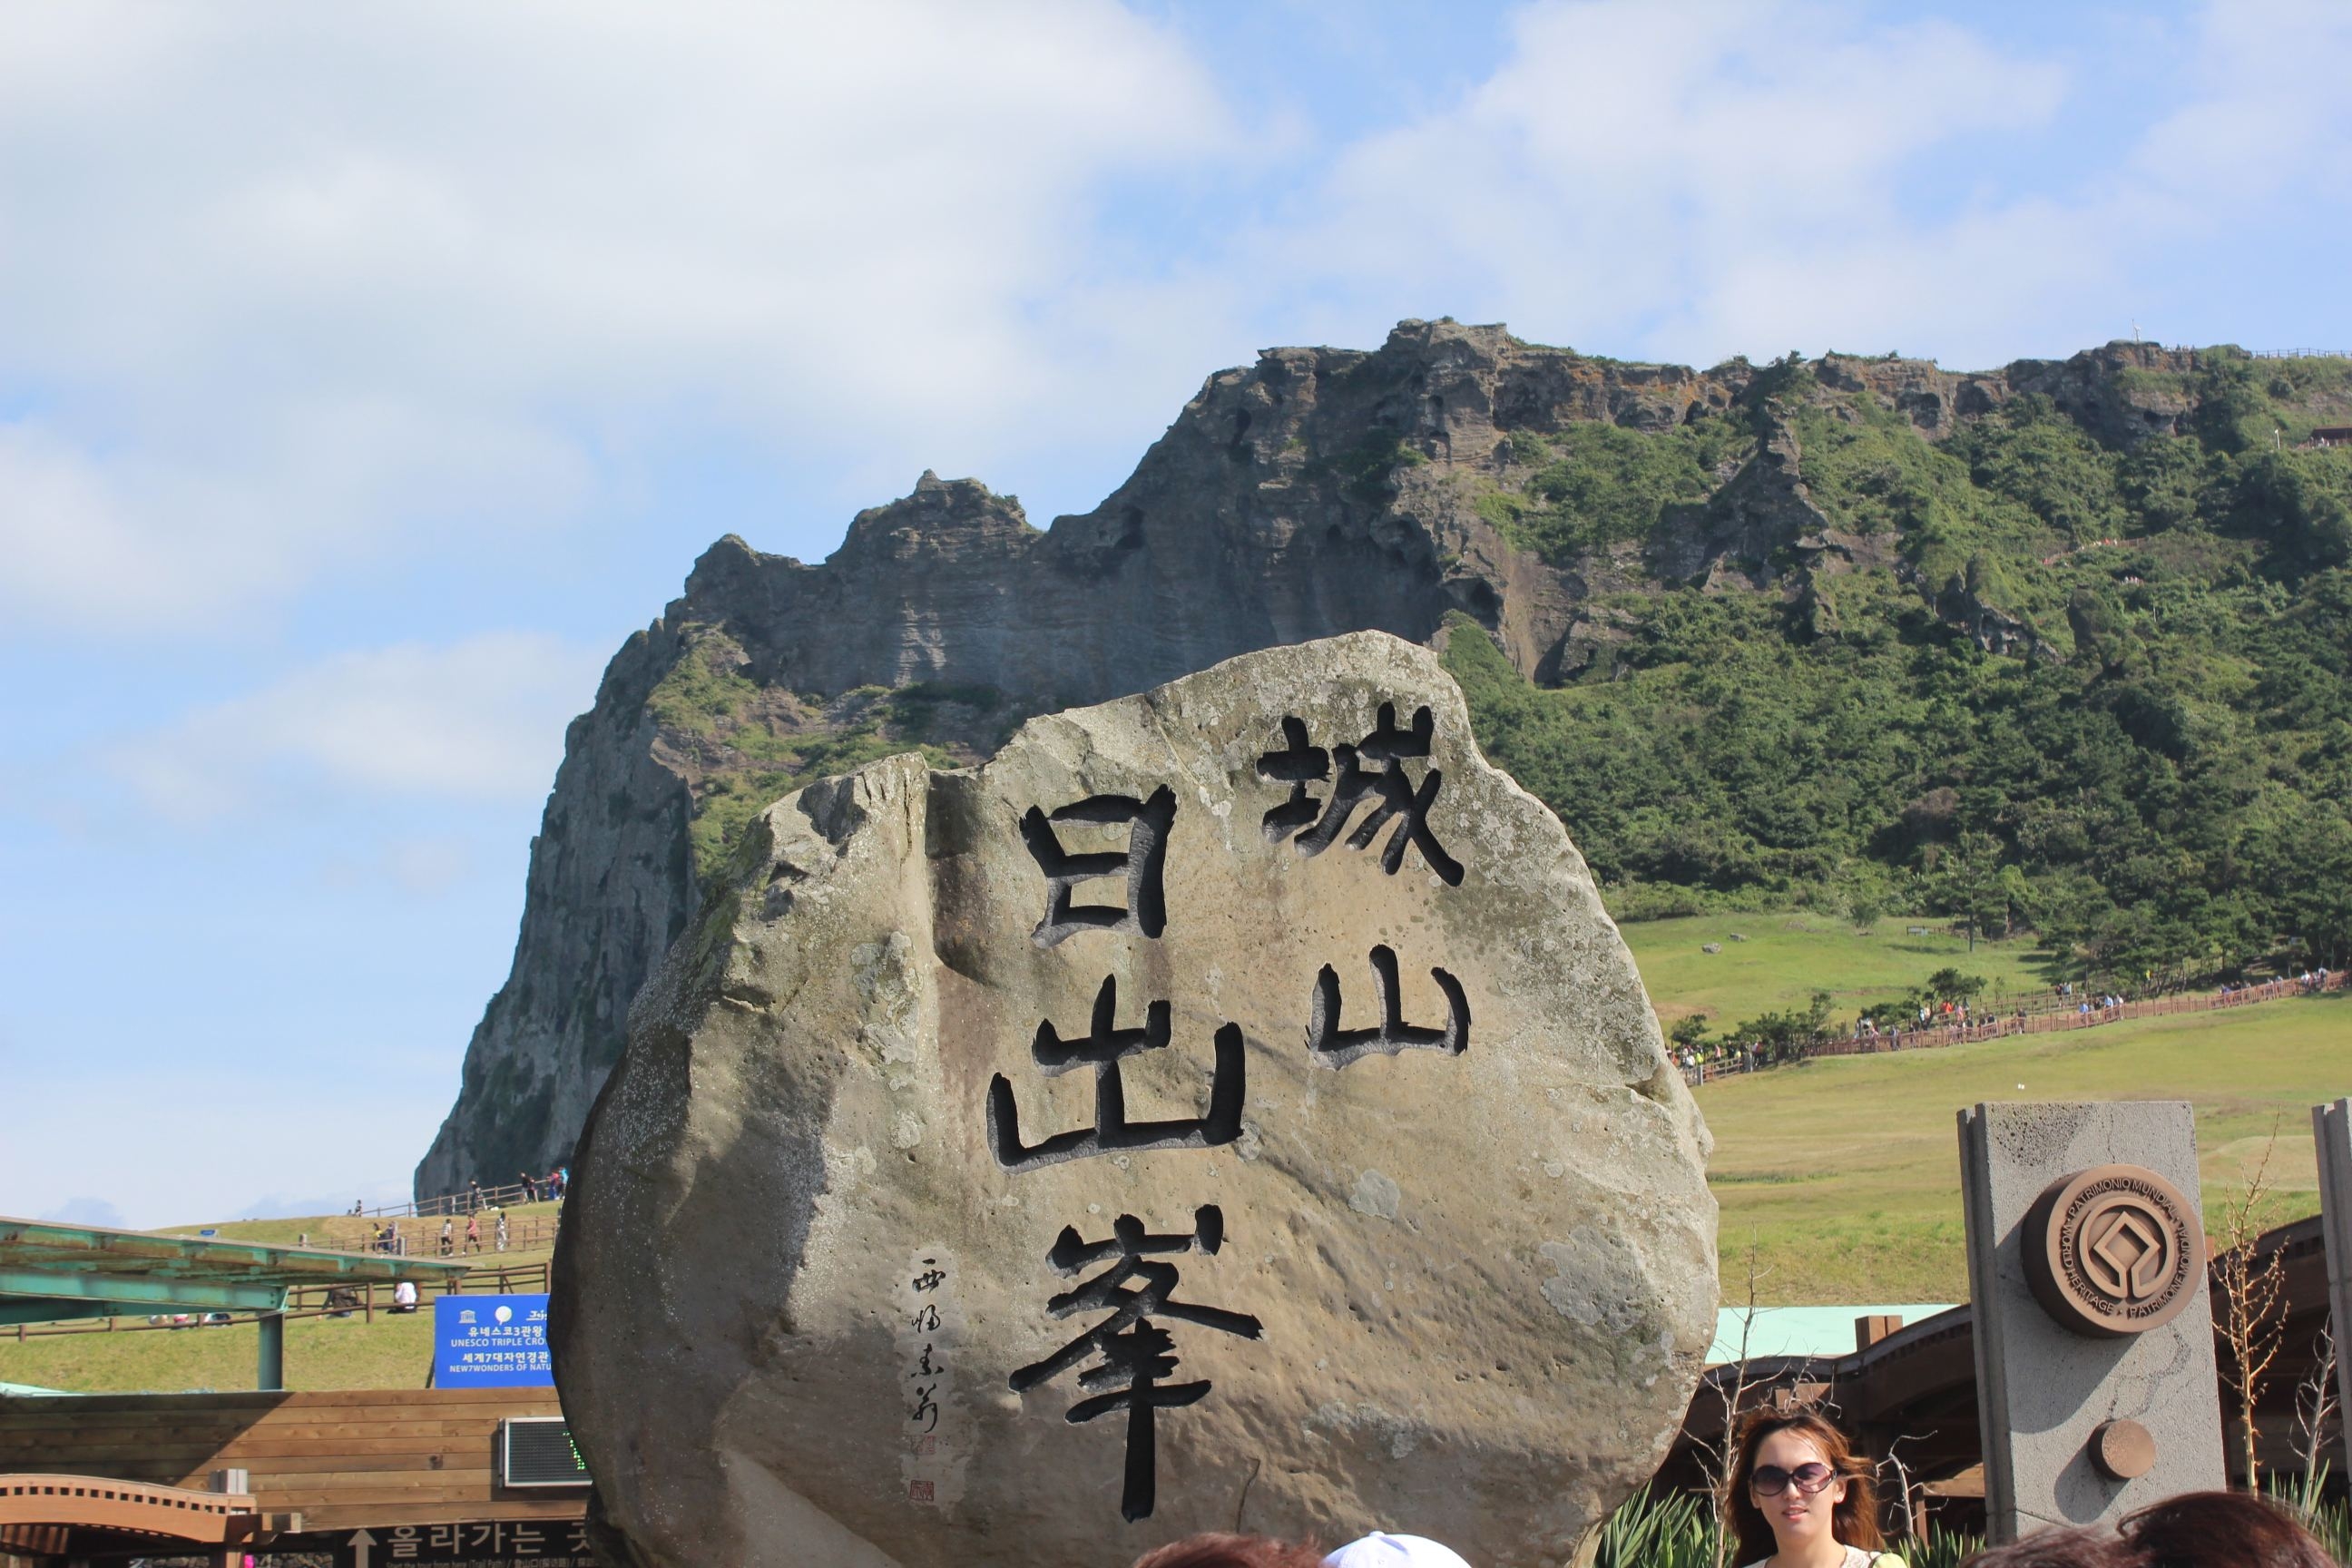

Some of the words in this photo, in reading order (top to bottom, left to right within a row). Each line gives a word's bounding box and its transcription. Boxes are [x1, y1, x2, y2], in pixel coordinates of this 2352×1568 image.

[2068, 1178, 2131, 1220] PATRIMONIO
[2132, 1180, 2180, 1220] MUNDIAL
[2060, 1223, 2074, 1268] WORLD
[2130, 1273, 2184, 1317] PATRIMOINE
[2176, 1222, 2192, 1278] MONDIAL
[2065, 1267, 2114, 1314] HERITAGE
[451, 1338, 489, 1348] UNESCO
[491, 1338, 523, 1347] TRIPLE
[525, 1338, 546, 1346] CRO
[468, 1325, 544, 1338] 유네스코3관왕
[449, 1364, 514, 1373] NEW7WONDERS
[463, 1351, 549, 1364] 세계7대자연경관
[387, 1523, 545, 1558] 올라가는
